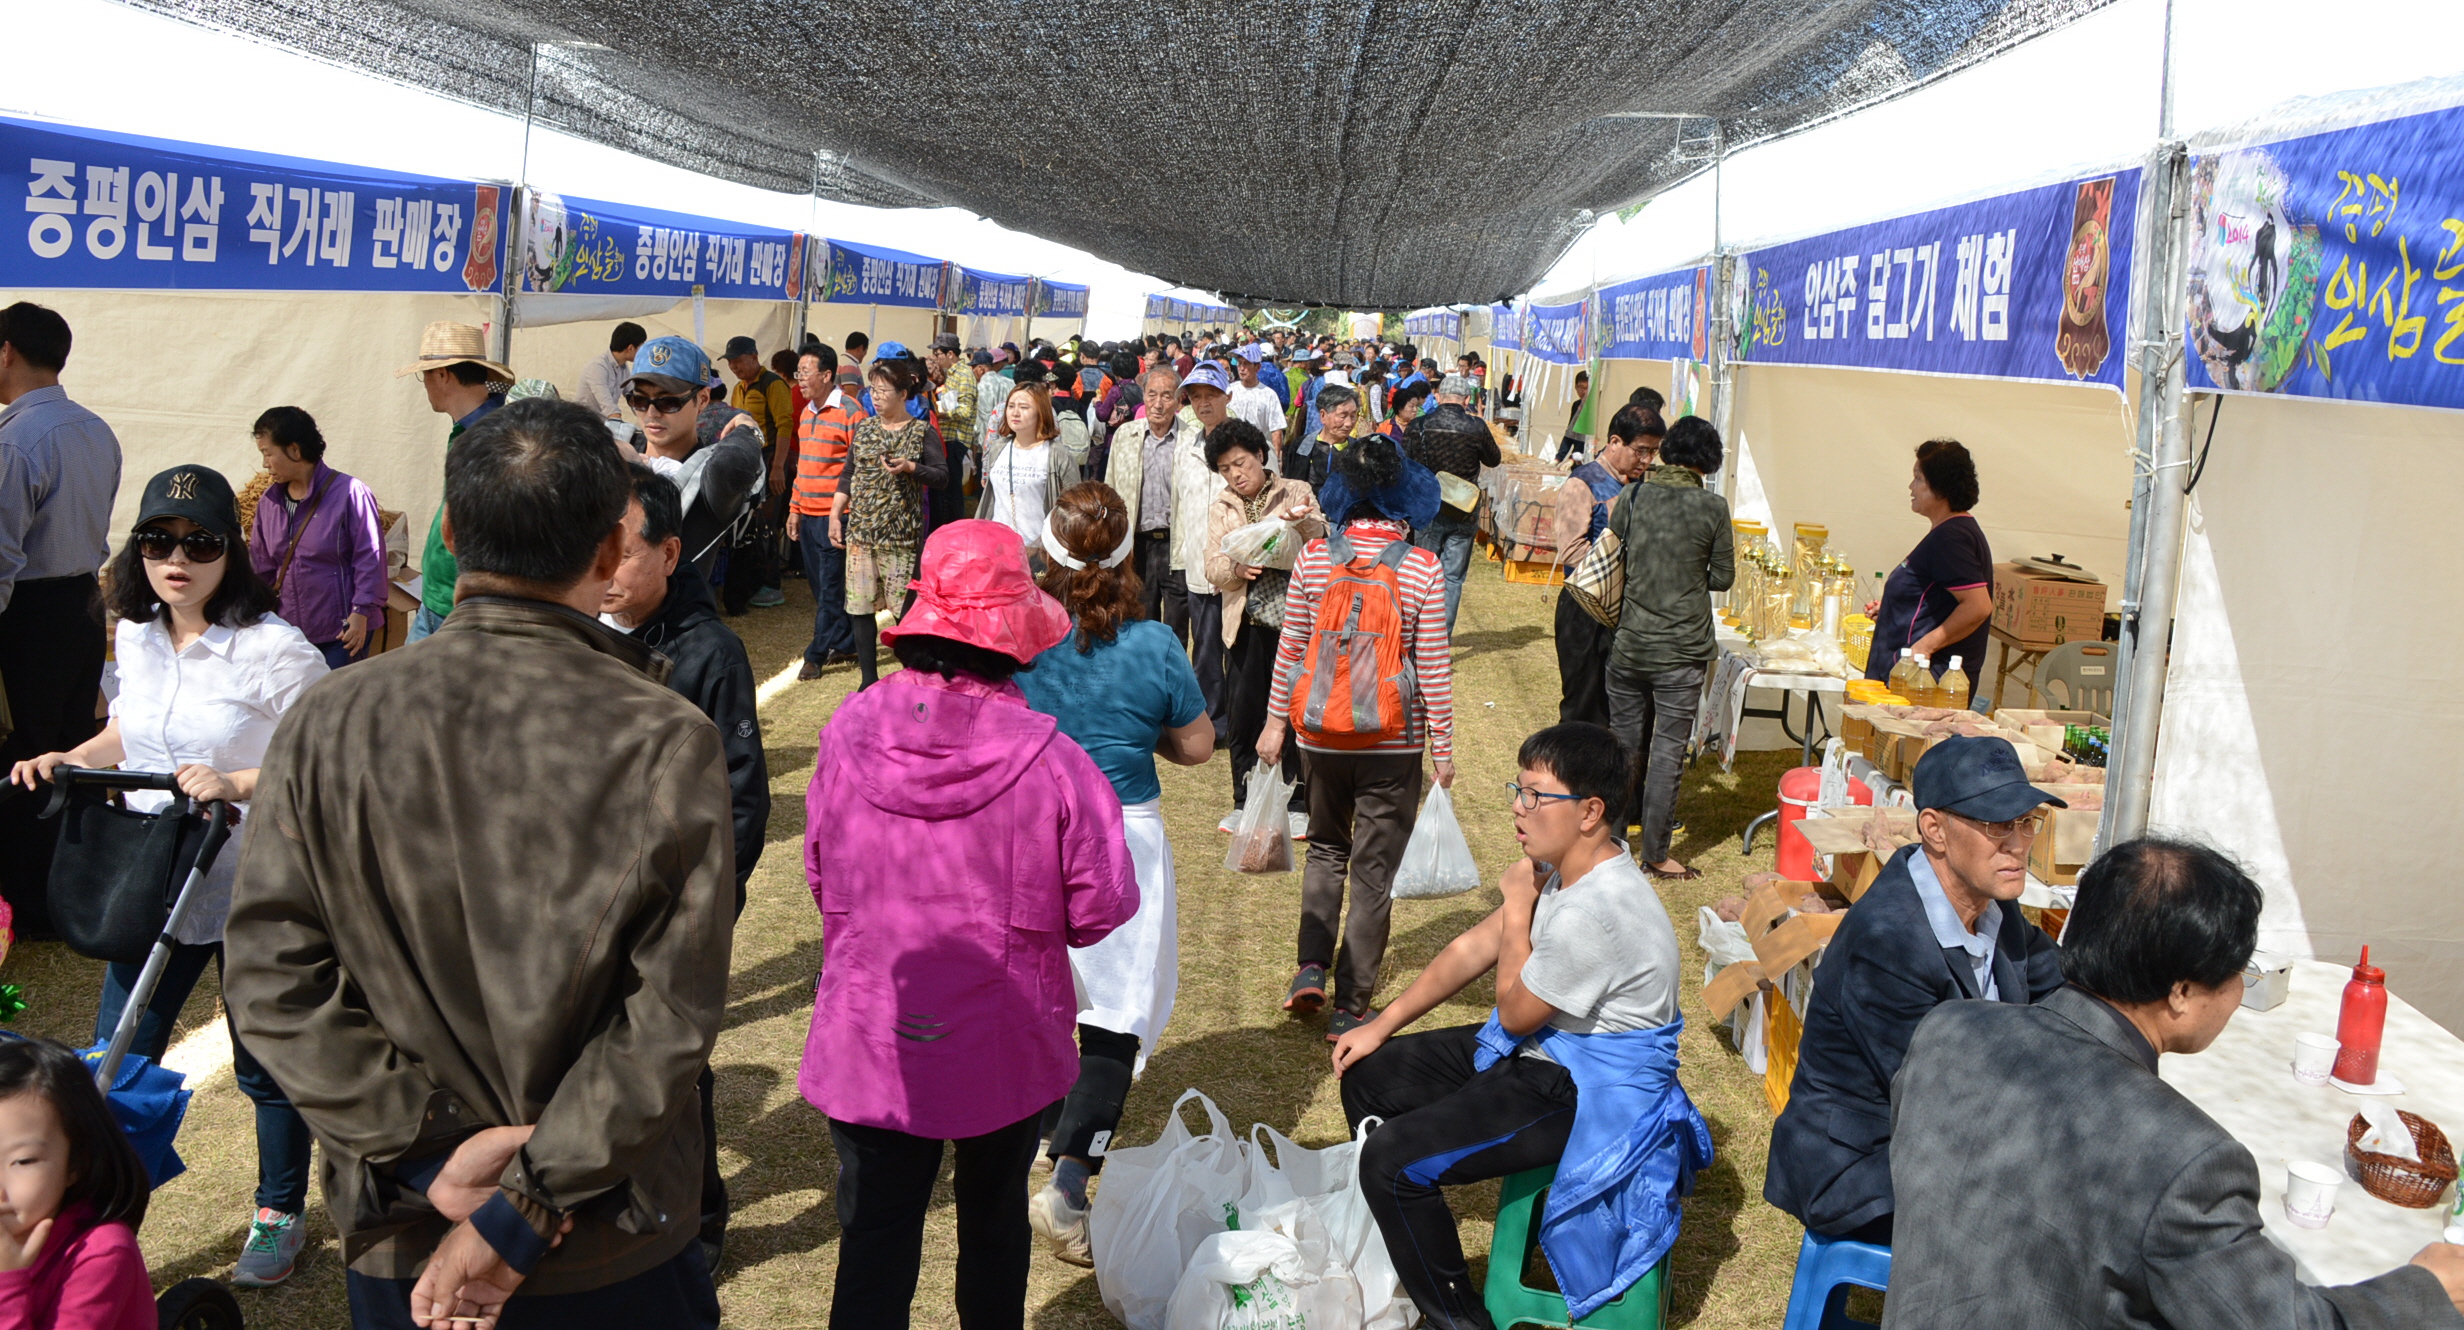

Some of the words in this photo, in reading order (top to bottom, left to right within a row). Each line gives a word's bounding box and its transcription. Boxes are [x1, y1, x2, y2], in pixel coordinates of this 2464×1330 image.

[25, 157, 225, 263] 증평인삼
[246, 182, 356, 268] 직거래
[371, 197, 463, 273] 판매장
[2226, 222, 2249, 245] 2014
[635, 226, 700, 282] 증평인삼
[705, 234, 746, 285] 직거래
[750, 241, 786, 288] 판매장
[861, 256, 894, 295] 증평인삼
[896, 262, 918, 297] 직거래
[918, 266, 939, 300] 판매장
[1804, 255, 1860, 340] 인삼주
[1867, 240, 1941, 341] 담그기
[1949, 228, 2016, 341] 체험
